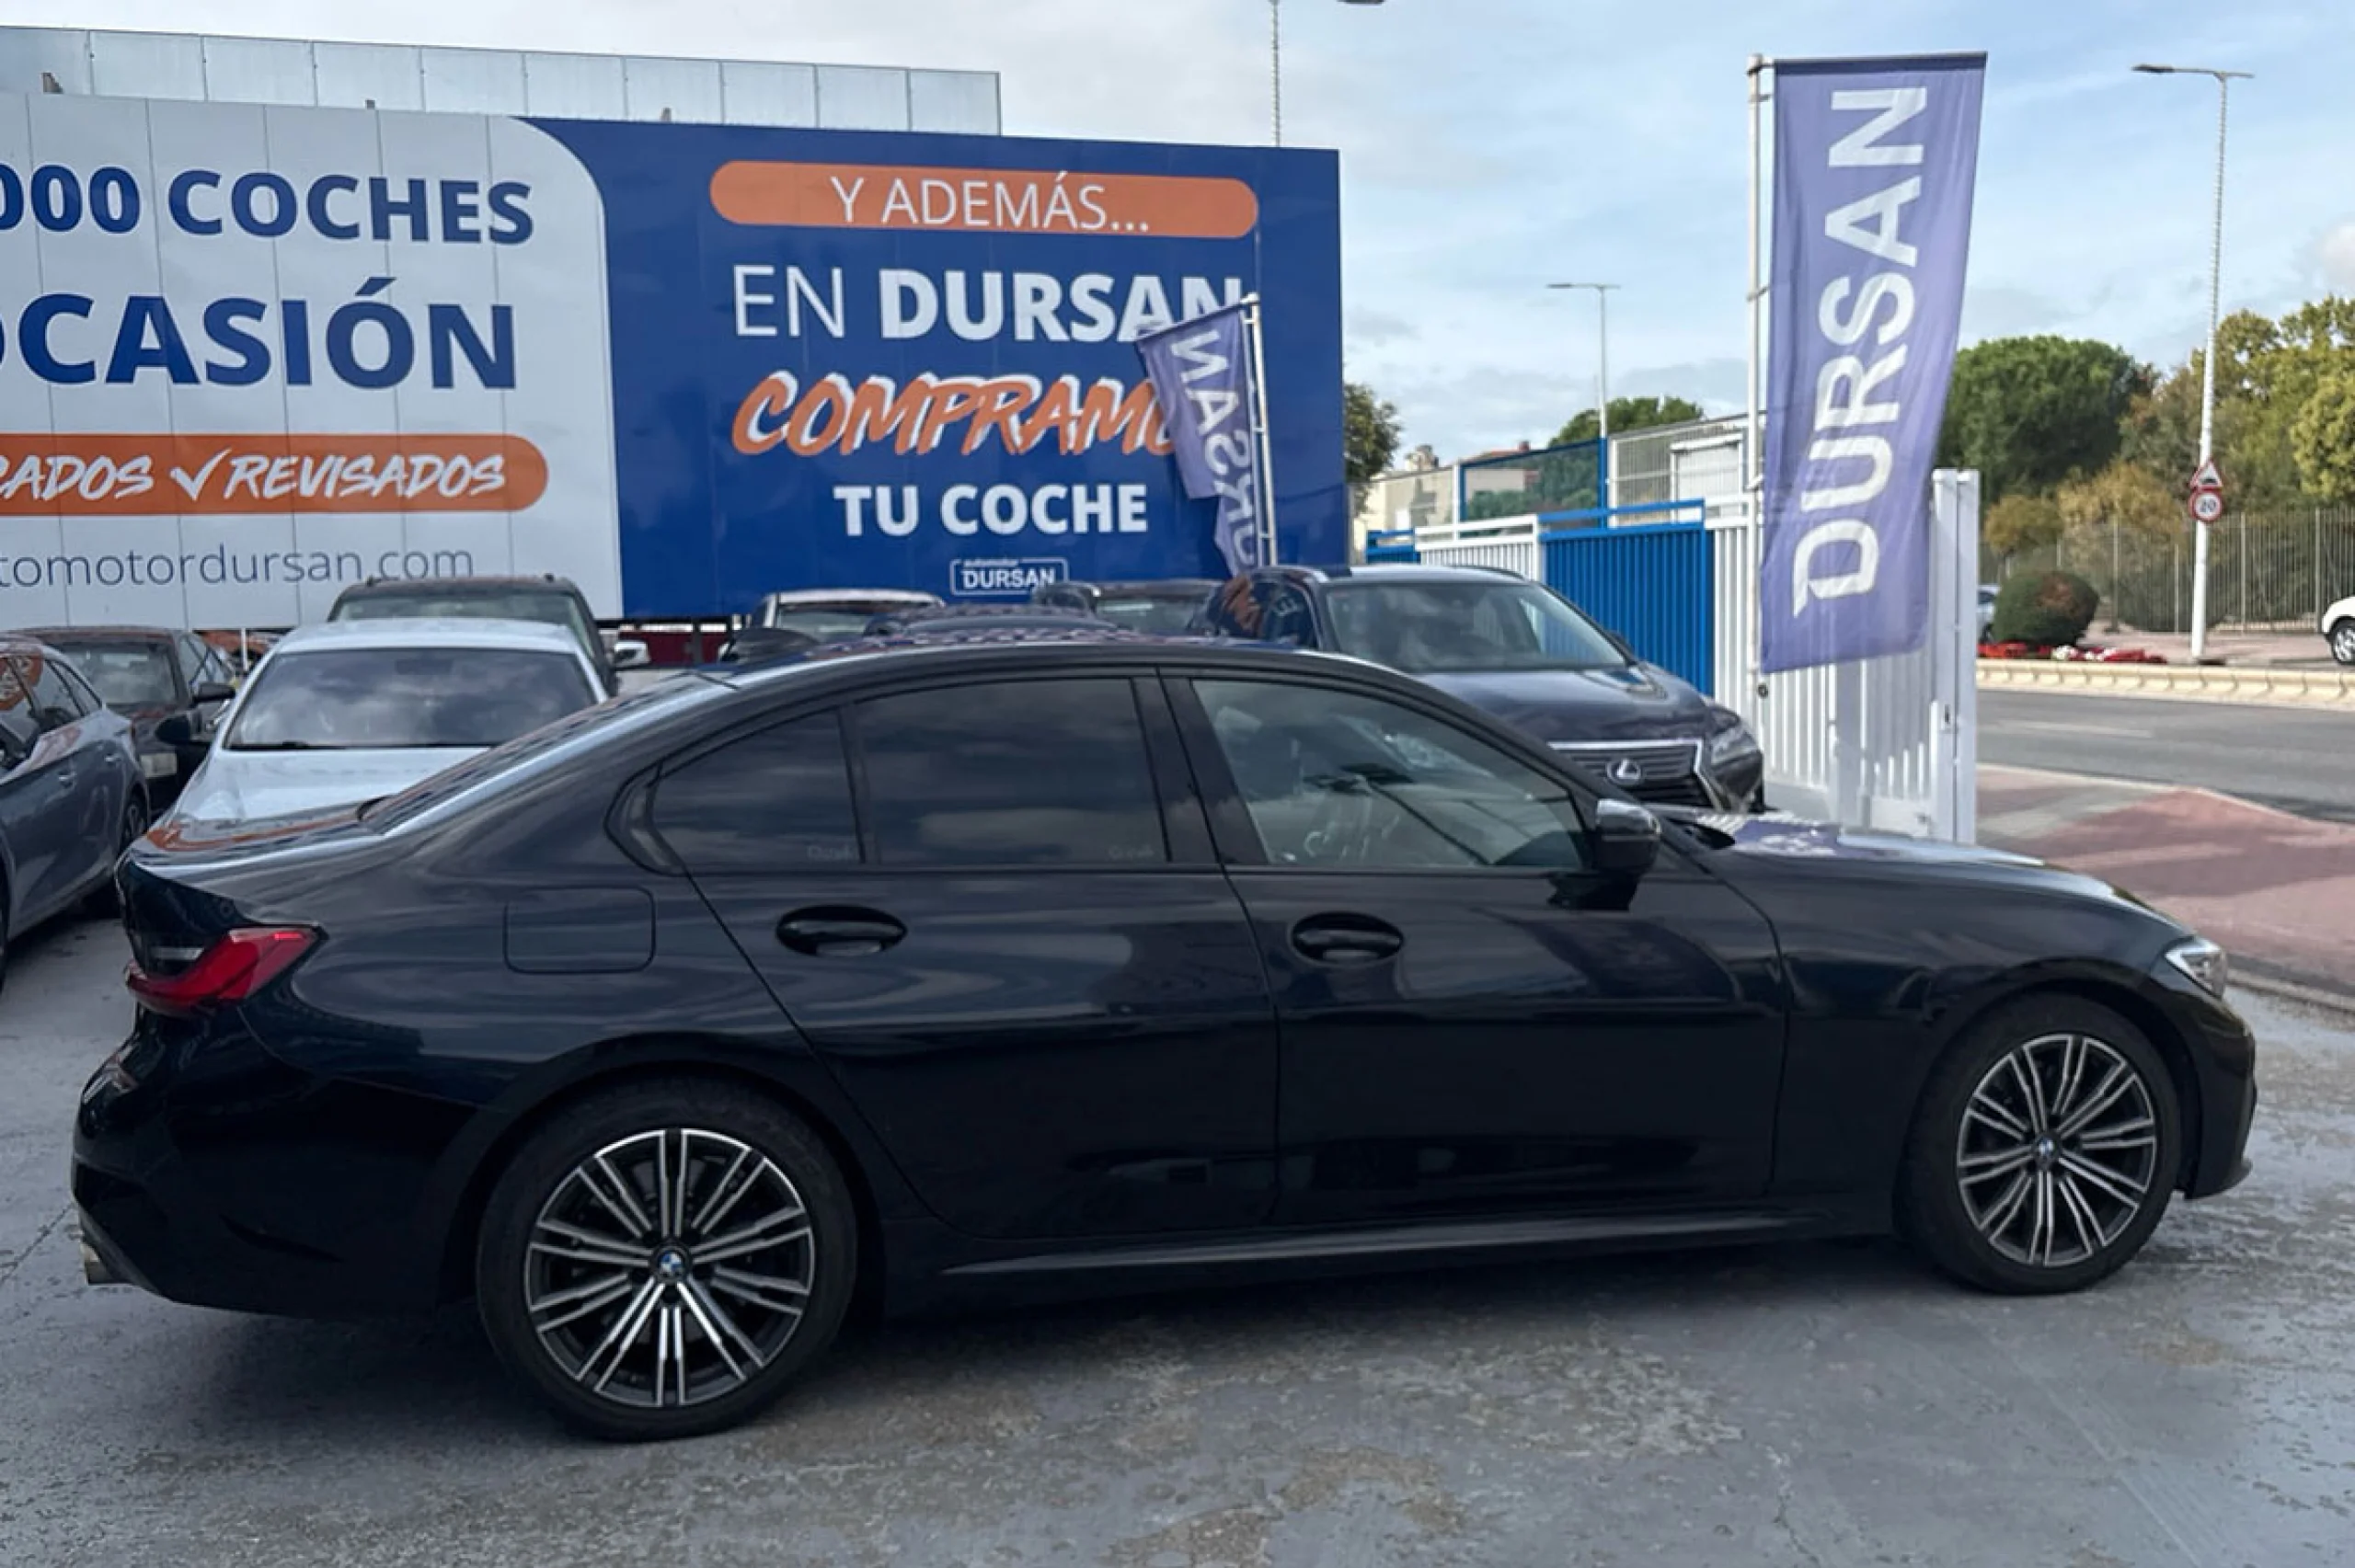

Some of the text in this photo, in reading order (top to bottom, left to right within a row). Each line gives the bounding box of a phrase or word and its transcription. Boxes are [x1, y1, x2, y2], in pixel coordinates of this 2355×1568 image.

[168, 169, 534, 245] COCHES
[831, 170, 1150, 233] Y ADEMÁS...
[0, 277, 517, 390] CASIÓN
[735, 266, 845, 338] EN
[1793, 87, 1927, 616] DURSAN
[223, 452, 505, 501] REVISADOS
[833, 484, 1148, 536] TU COCHE
[961, 567, 1056, 589] DURSAN
